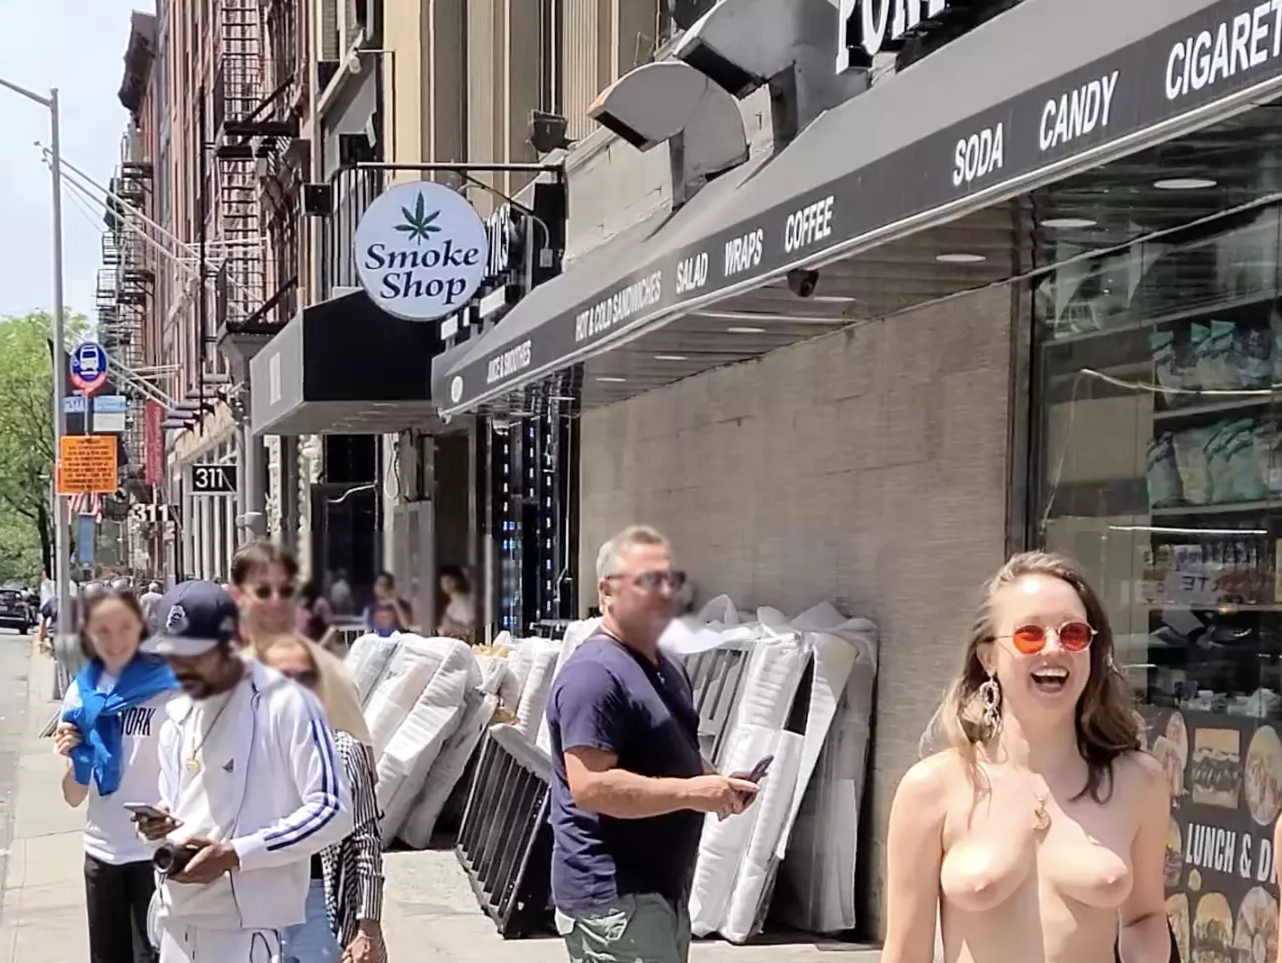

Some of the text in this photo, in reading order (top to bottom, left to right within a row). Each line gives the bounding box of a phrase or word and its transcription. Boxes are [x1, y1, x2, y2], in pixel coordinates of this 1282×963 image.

[1039, 70, 1120, 151] CANDY
[952, 122, 1004, 186] SODA
[785, 196, 835, 253] COFFEE
[365, 239, 479, 270] Smoke
[676, 252, 708, 294] SALAD
[724, 228, 763, 277] WRAPS
[380, 270, 467, 305] Shop
[195, 468, 223, 488] 311
[132, 503, 168, 522] 311
[1185, 822, 1236, 874] LUNCH
[1240, 833, 1252, 878] &
